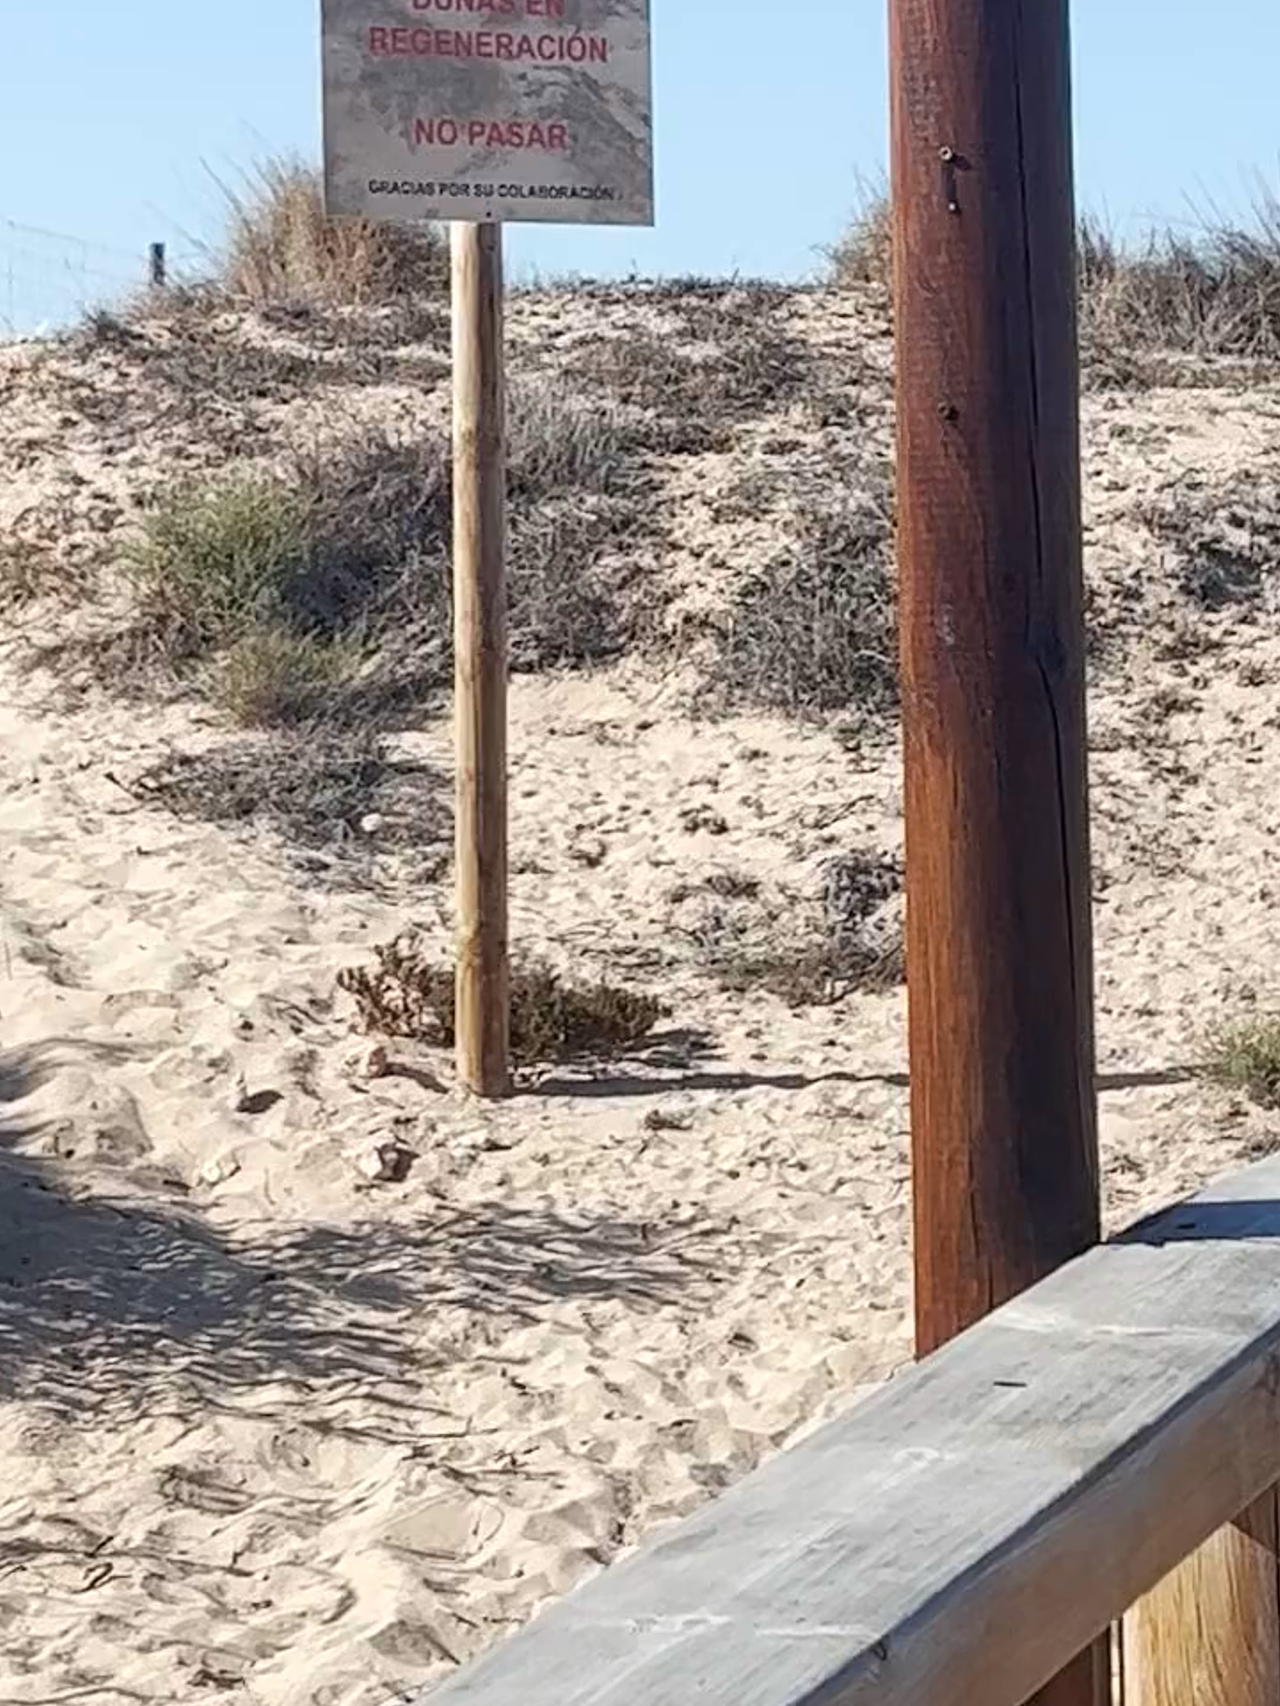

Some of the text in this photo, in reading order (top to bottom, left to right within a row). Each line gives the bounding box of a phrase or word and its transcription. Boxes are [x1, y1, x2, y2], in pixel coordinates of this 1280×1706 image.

[369, 26, 608, 64] REGENERACIÓN
[415, 119, 568, 150] NO PASAR
[368, 179, 436, 197] GRACIAS
[438, 182, 470, 198] POR
[472, 183, 494, 198] SU
